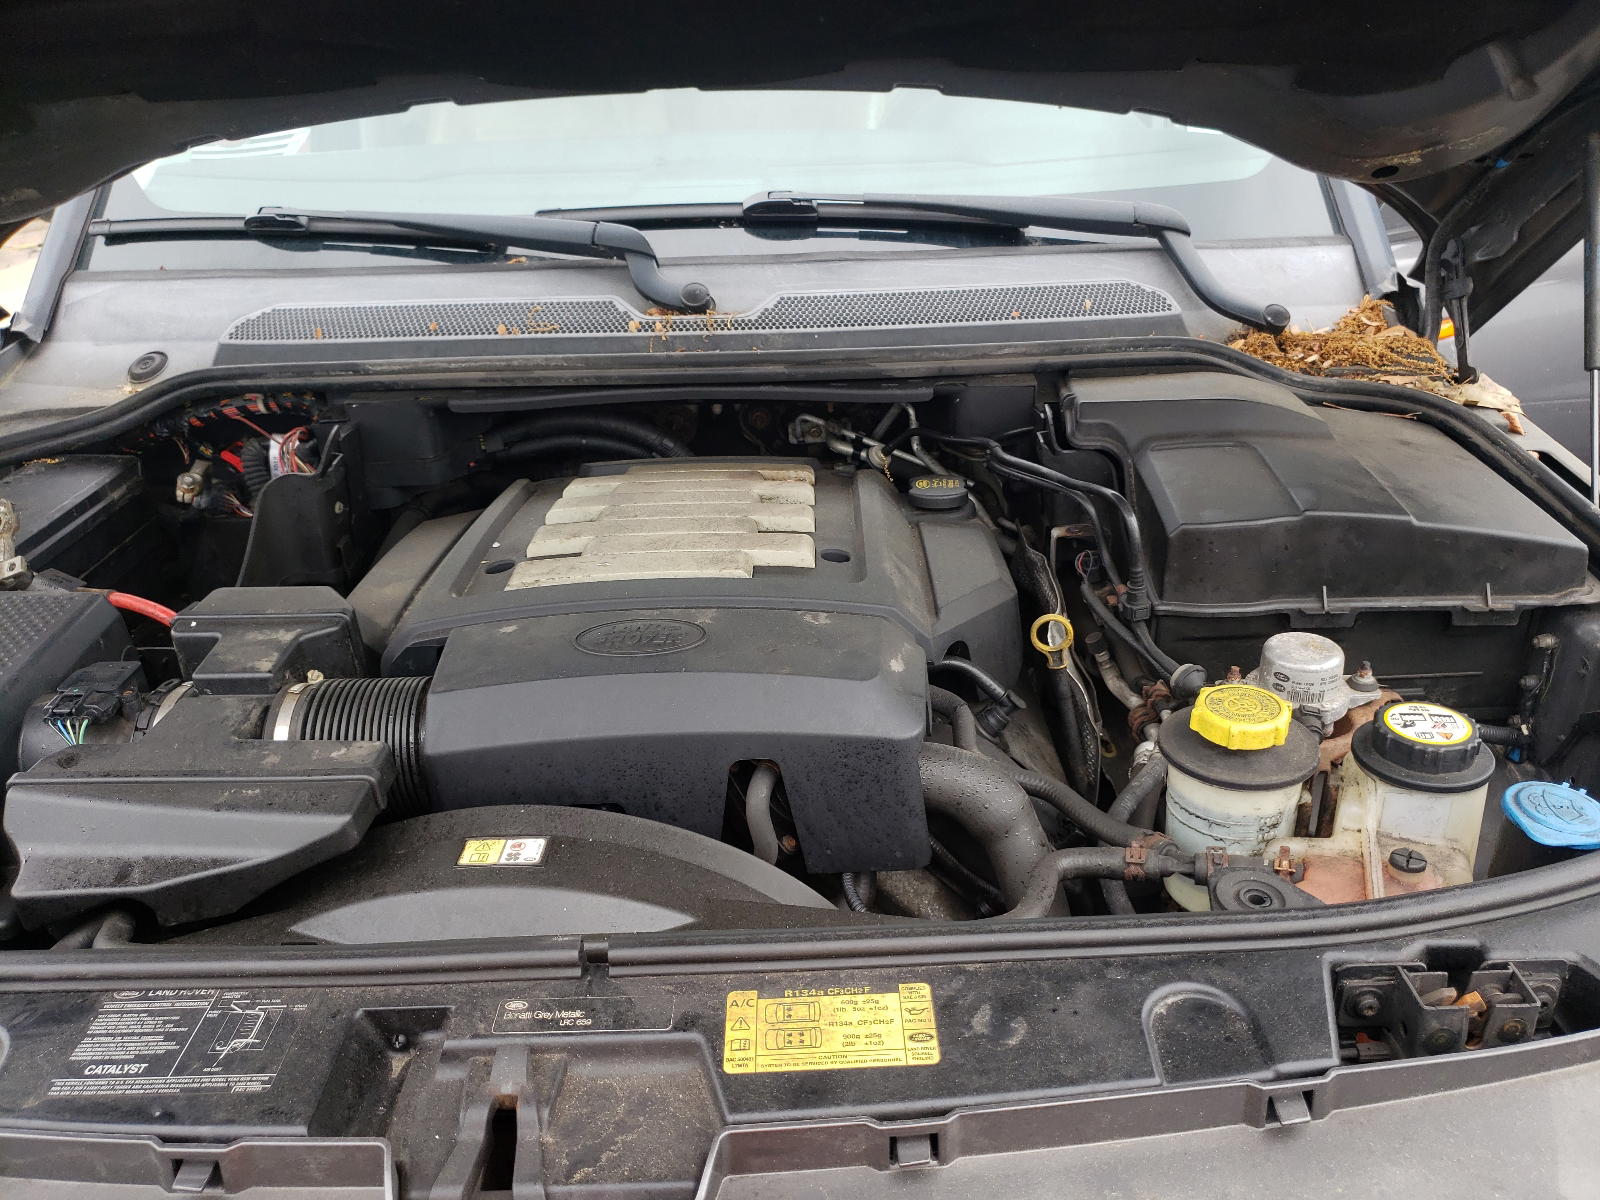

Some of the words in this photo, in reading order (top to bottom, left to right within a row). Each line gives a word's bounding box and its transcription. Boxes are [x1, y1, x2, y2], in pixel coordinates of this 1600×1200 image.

[784, 988, 824, 998] R134a
[729, 998, 755, 1008] A/C
[534, 1010, 554, 1020] Grey
[554, 1009, 585, 1018] Metallic
[576, 1018, 592, 1026] 659
[83, 1063, 149, 1075] CATALYST
